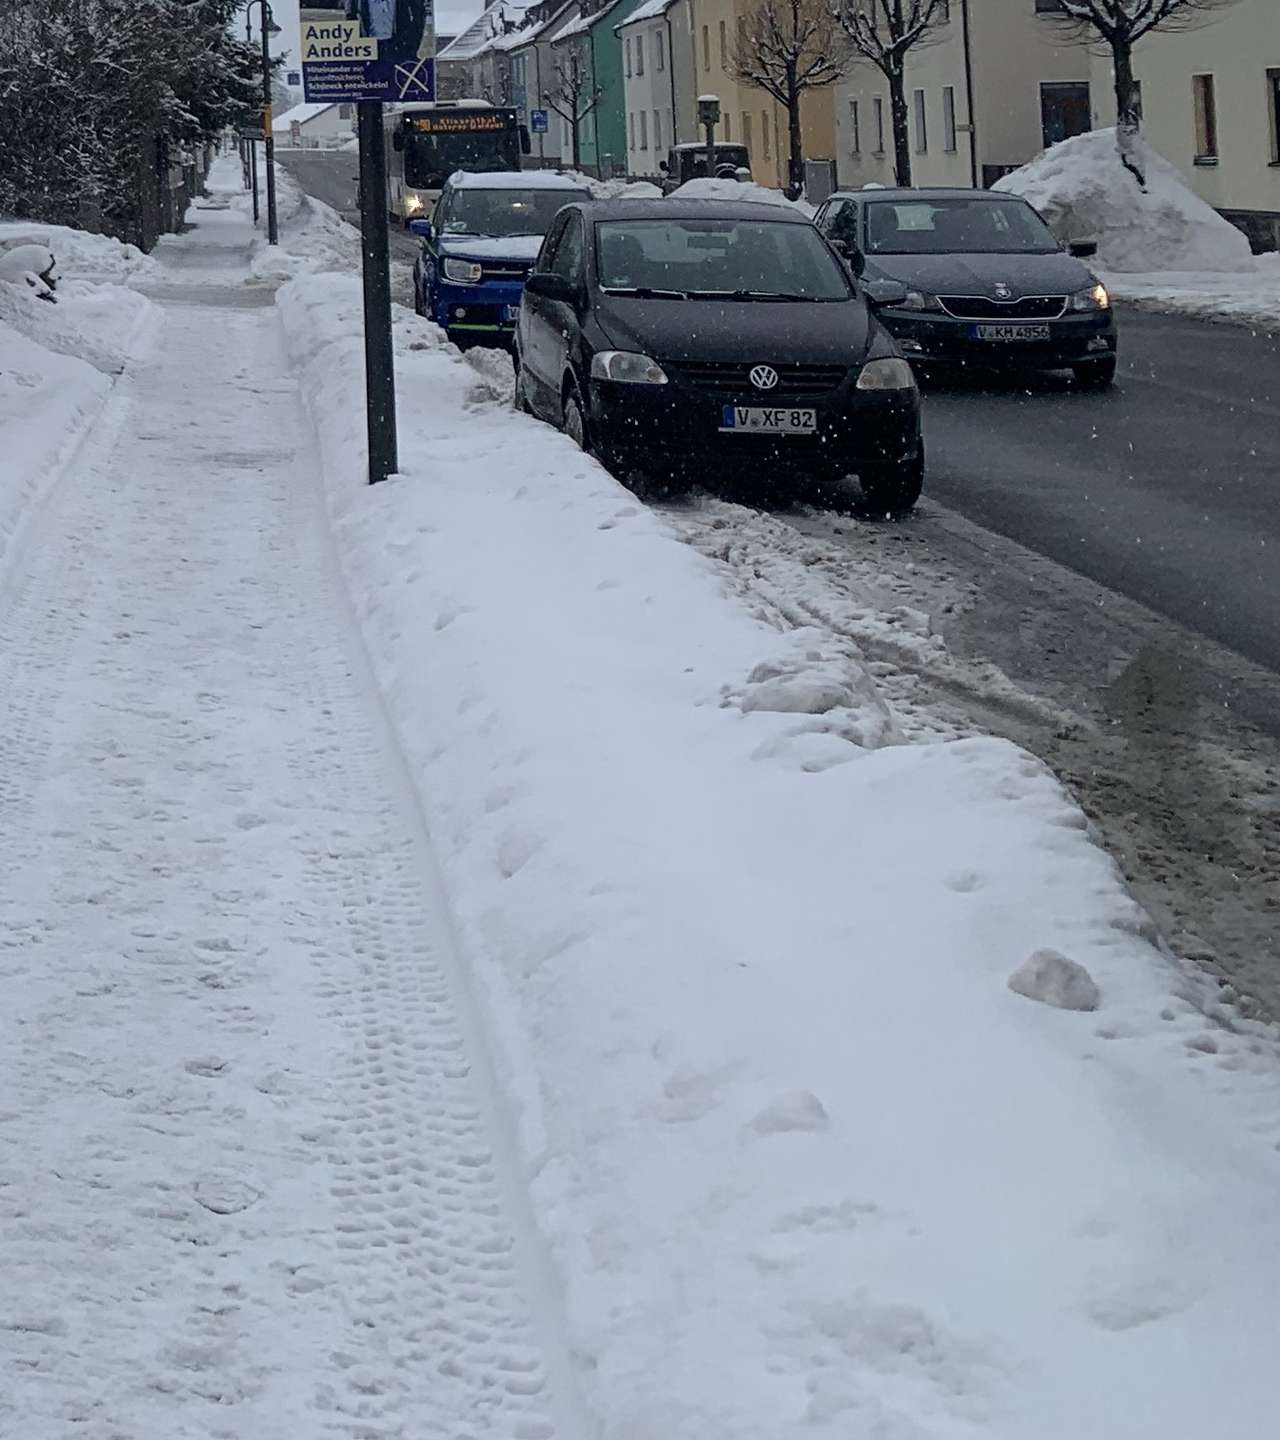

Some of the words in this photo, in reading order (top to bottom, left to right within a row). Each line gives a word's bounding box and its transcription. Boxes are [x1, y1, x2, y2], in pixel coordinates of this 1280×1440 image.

[305, 24, 354, 43] Andy
[306, 42, 372, 58] Anders
[737, 409, 749, 426] V
[762, 410, 786, 427] XF
[790, 411, 813, 428] 82
